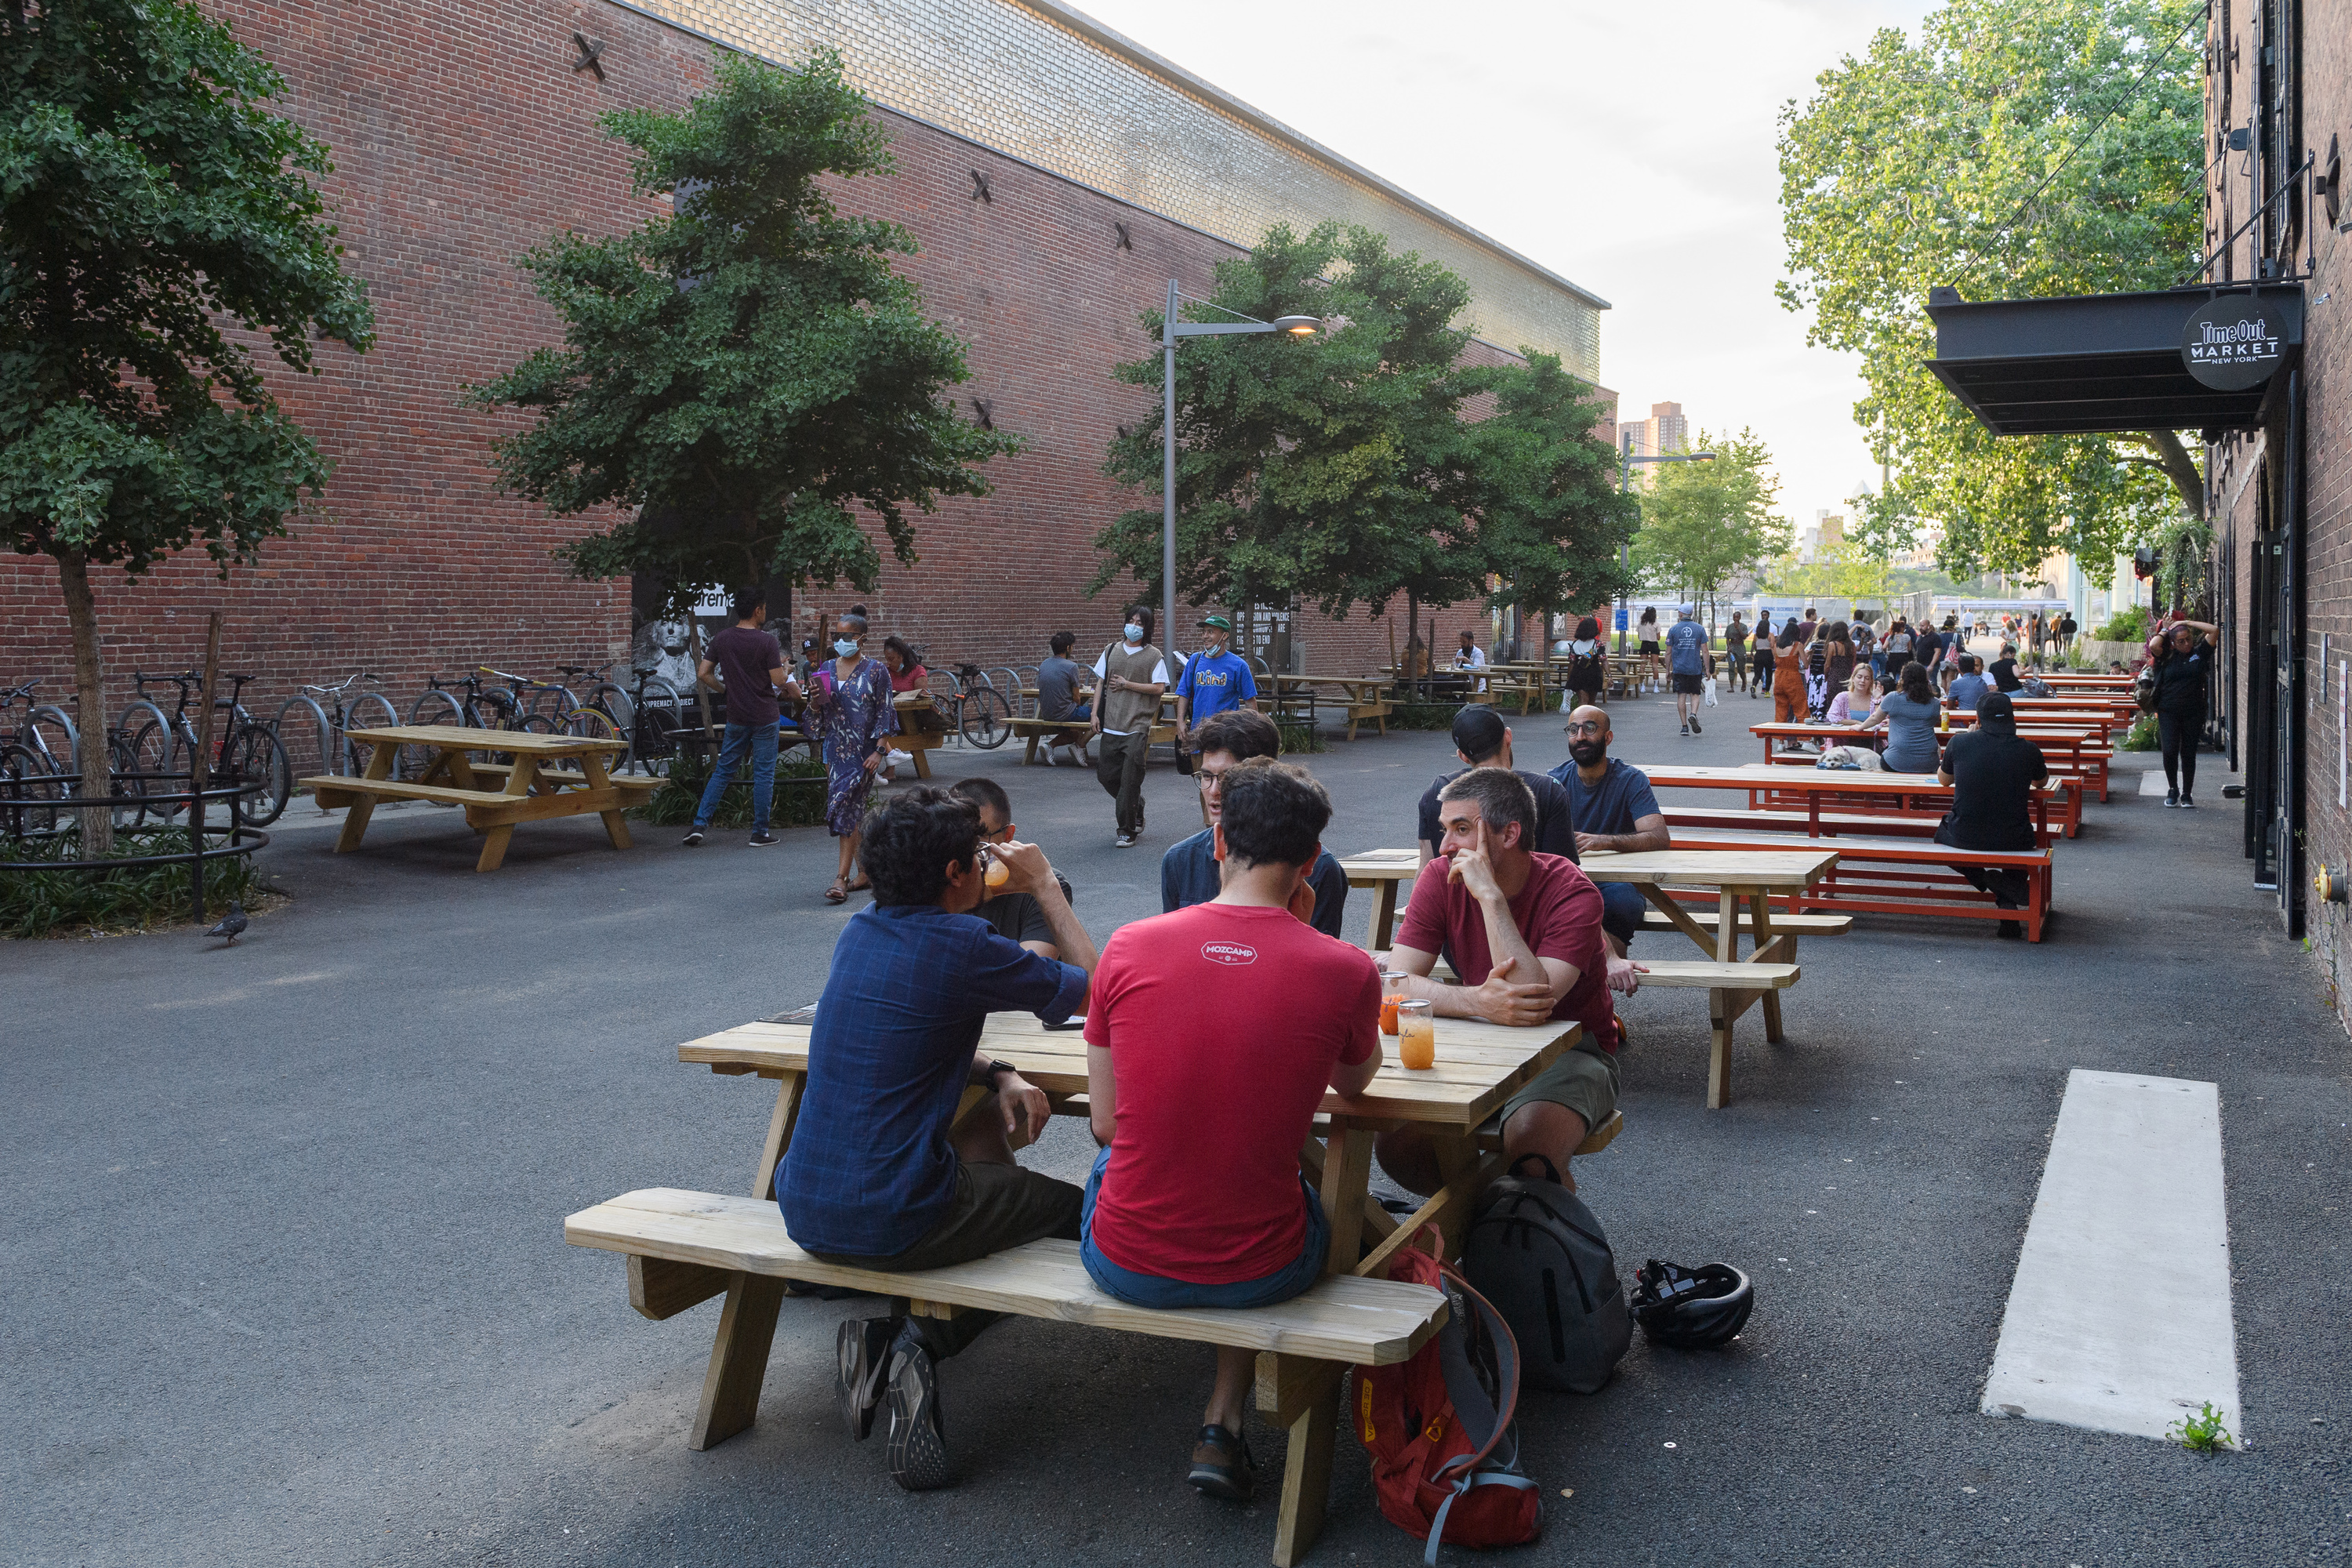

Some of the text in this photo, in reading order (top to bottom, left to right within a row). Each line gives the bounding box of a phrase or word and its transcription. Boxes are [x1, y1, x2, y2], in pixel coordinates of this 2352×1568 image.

[2200, 318, 2266, 345] Time Out
[2191, 342, 2278, 358] MARKET
[1236, 612, 1262, 622] OPPSION
[1262, 612, 1272, 622] AND
[1277, 623, 1286, 633] ARE
[1255, 635, 1262, 645] TO
[1262, 635, 1271, 644] END
[1255, 646, 1265, 656] ART
[1206, 946, 1254, 957] MOZCAMP
